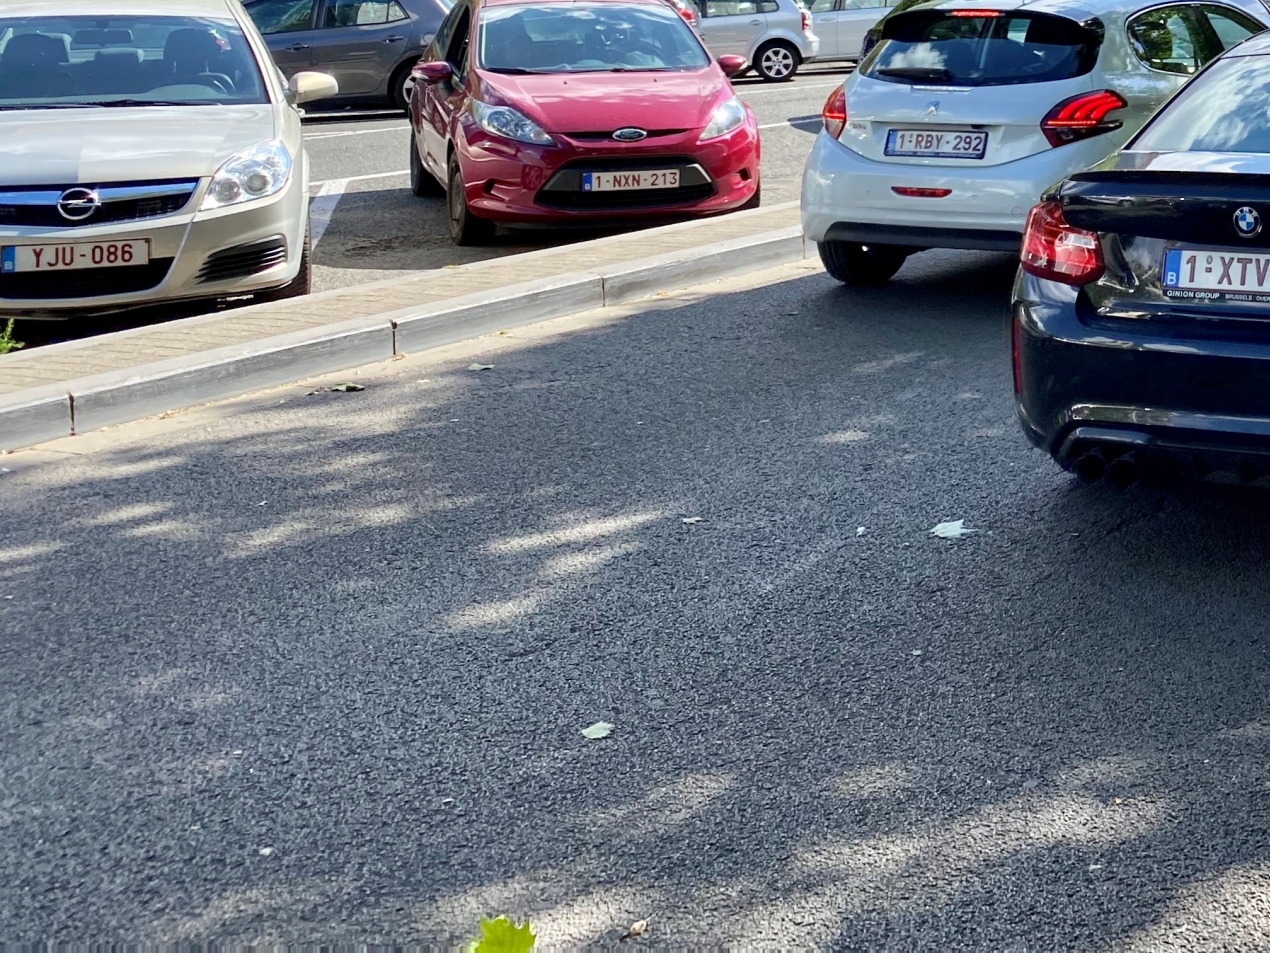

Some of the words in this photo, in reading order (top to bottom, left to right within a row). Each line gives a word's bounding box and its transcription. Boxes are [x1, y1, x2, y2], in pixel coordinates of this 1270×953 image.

[899, 132, 983, 153] 1-RBY-292
[595, 172, 678, 189] 1-NXN-213
[32, 243, 133, 268] YJU-086
[1167, 271, 1177, 285] B
[1166, 289, 1194, 298] GINION
[1195, 291, 1220, 299] GROUP
[1225, 293, 1252, 301] BRUSSELS
